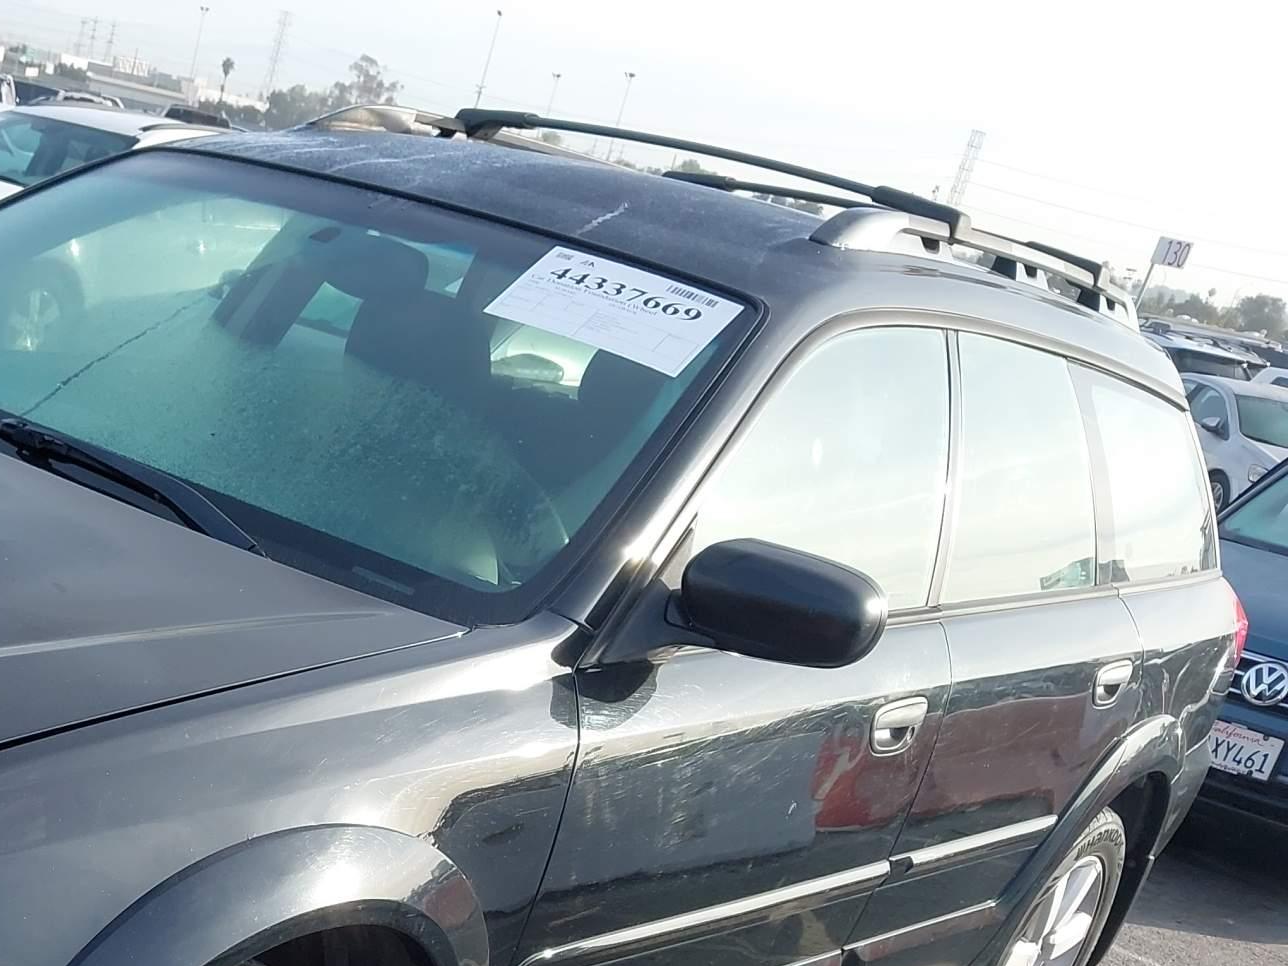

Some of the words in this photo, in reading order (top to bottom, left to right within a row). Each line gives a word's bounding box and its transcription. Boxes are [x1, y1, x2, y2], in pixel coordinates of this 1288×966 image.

[1162, 240, 1191, 268] 130
[550, 267, 702, 321] 44337669
[1208, 734, 1269, 774] XY461
